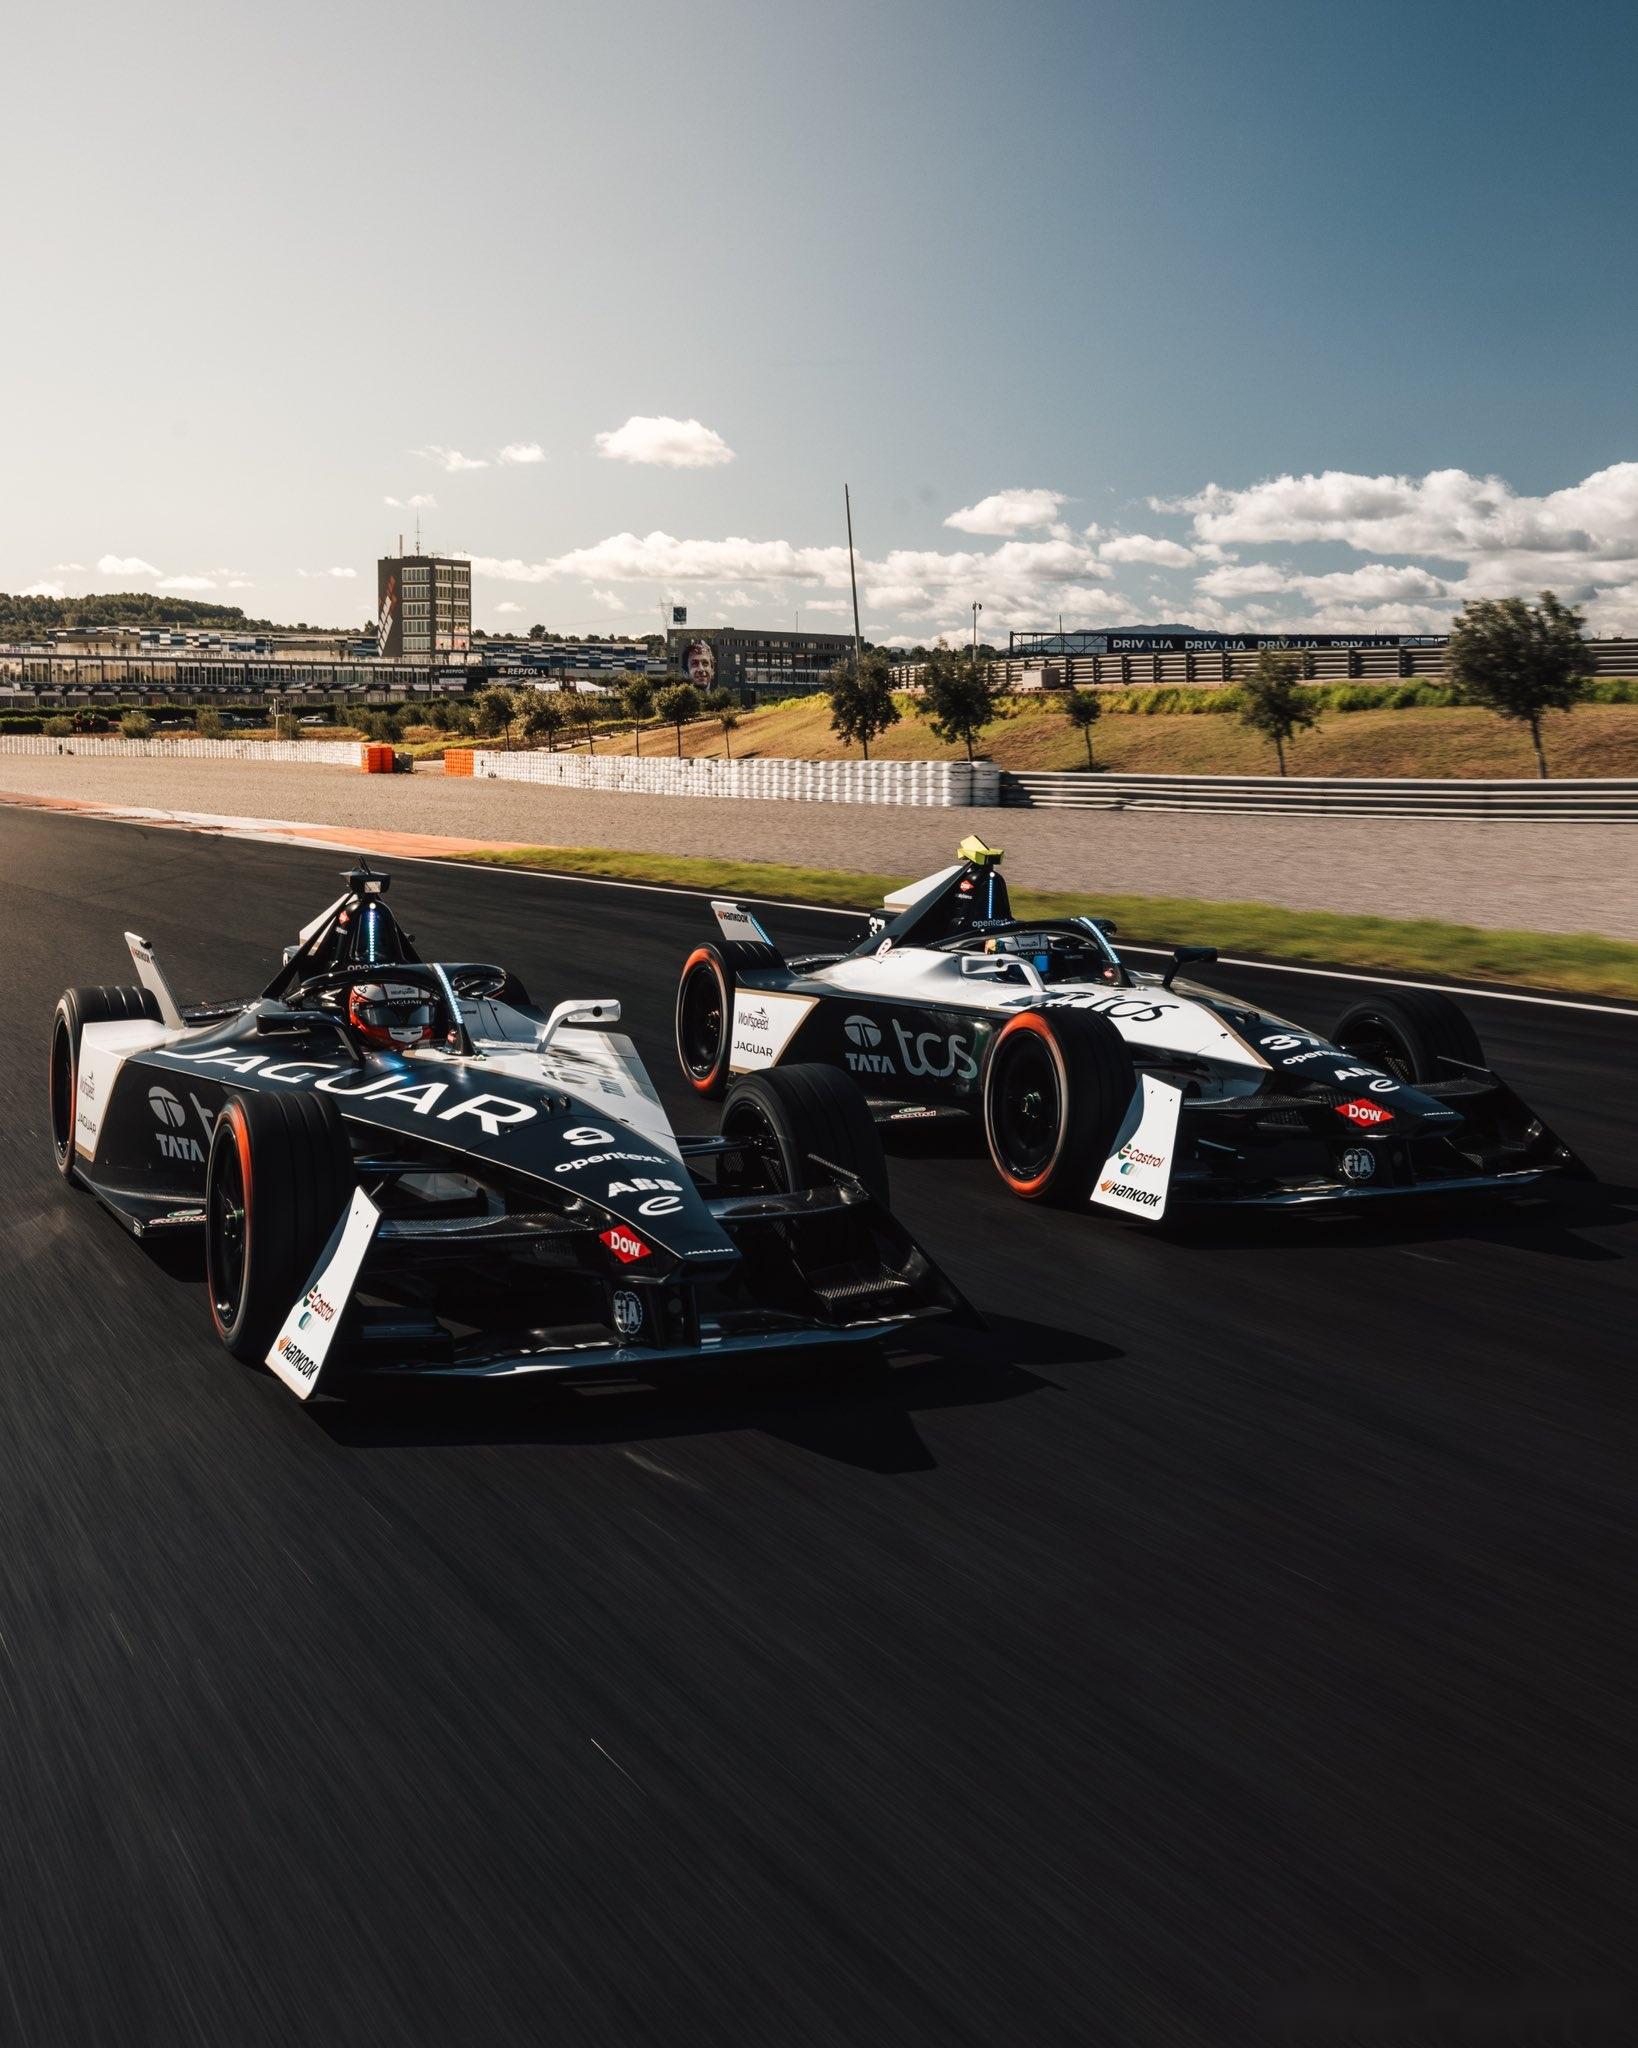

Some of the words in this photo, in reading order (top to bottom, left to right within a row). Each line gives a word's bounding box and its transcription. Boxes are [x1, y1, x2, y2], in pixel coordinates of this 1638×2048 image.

[507, 667, 538, 675] REPSOL
[734, 1040, 773, 1058] JAGUAR
[844, 1052, 897, 1075] TATA
[891, 1018, 978, 1080] tcs
[154, 1046, 539, 1137] JAGUAR
[155, 1132, 206, 1163] TATA
[562, 1126, 616, 1147] 9
[554, 1151, 668, 1173] opentext
[1129, 1148, 1166, 1168] Castrol
[607, 1177, 684, 1199] ABB
[311, 1292, 338, 1322] Castrol
